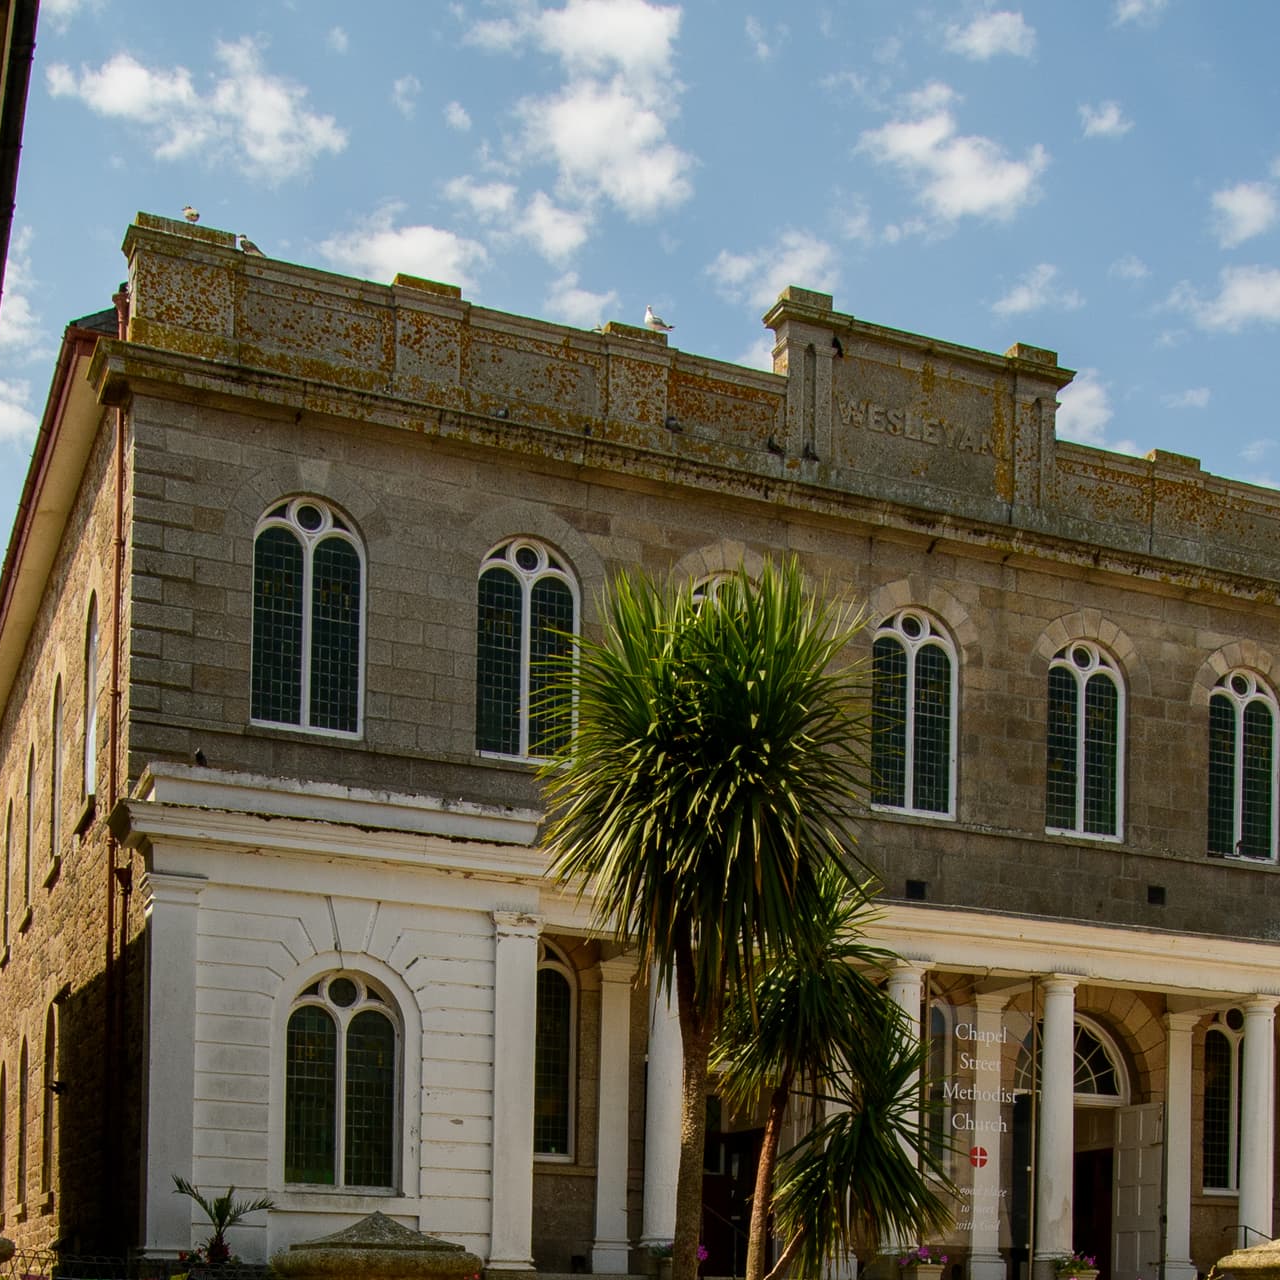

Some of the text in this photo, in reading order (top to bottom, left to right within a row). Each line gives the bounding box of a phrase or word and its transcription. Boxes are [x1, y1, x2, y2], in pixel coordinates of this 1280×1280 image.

[836, 398, 1004, 460] WESLEYAN
[955, 1023, 1007, 1047] Chapel
[959, 1052, 1002, 1072] Street
[942, 1082, 1018, 1104] Methodist
[952, 1112, 1008, 1133] Church
[960, 1204, 970, 1213] to
[956, 1219, 976, 1231] with
